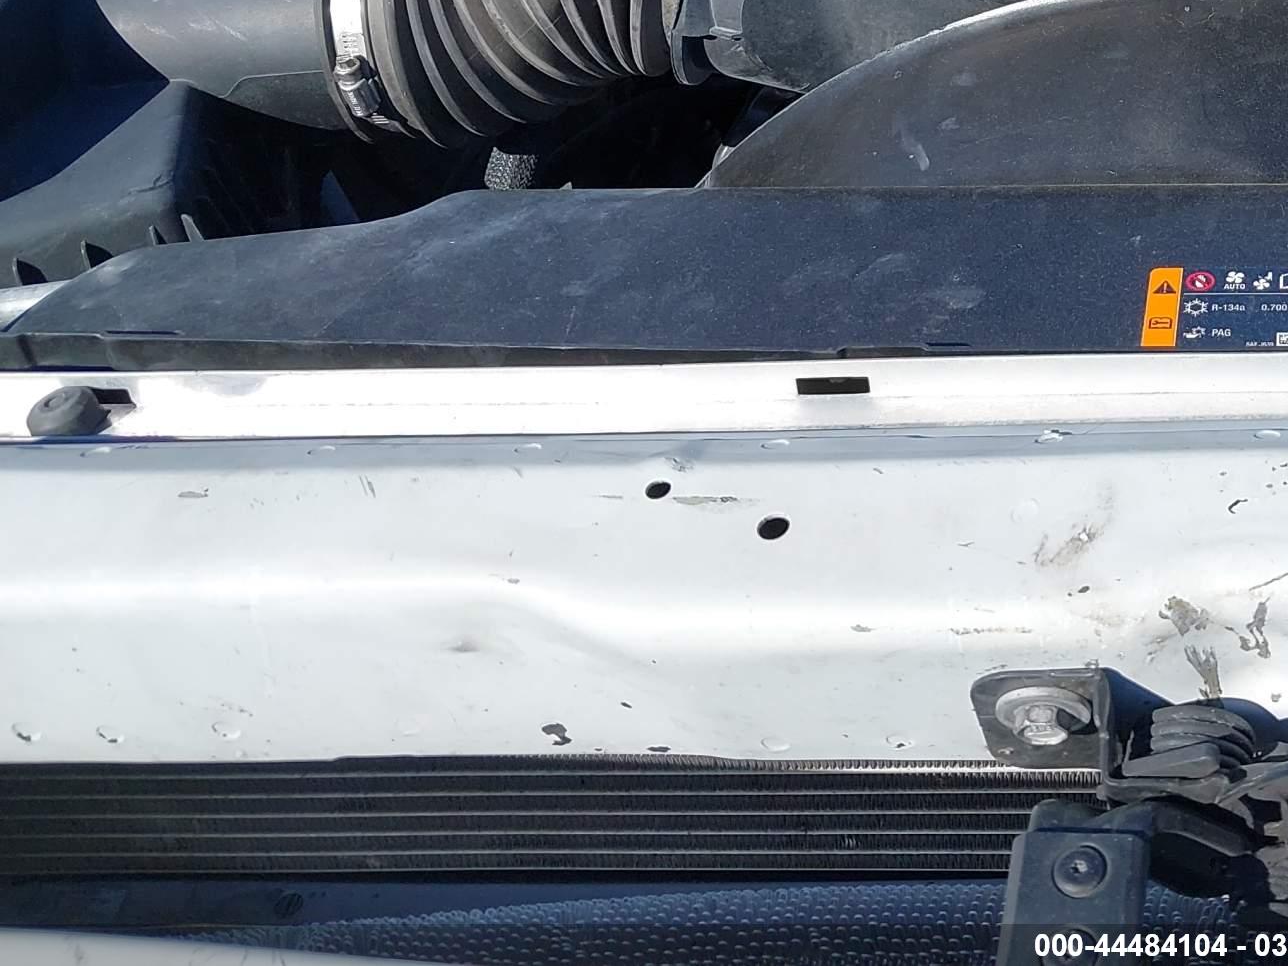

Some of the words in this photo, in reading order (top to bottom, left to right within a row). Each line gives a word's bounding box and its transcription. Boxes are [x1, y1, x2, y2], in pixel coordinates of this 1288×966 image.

[1211, 303, 1246, 312] R-134a
[1261, 303, 1288, 312] 0.700
[1211, 328, 1232, 337] PAG
